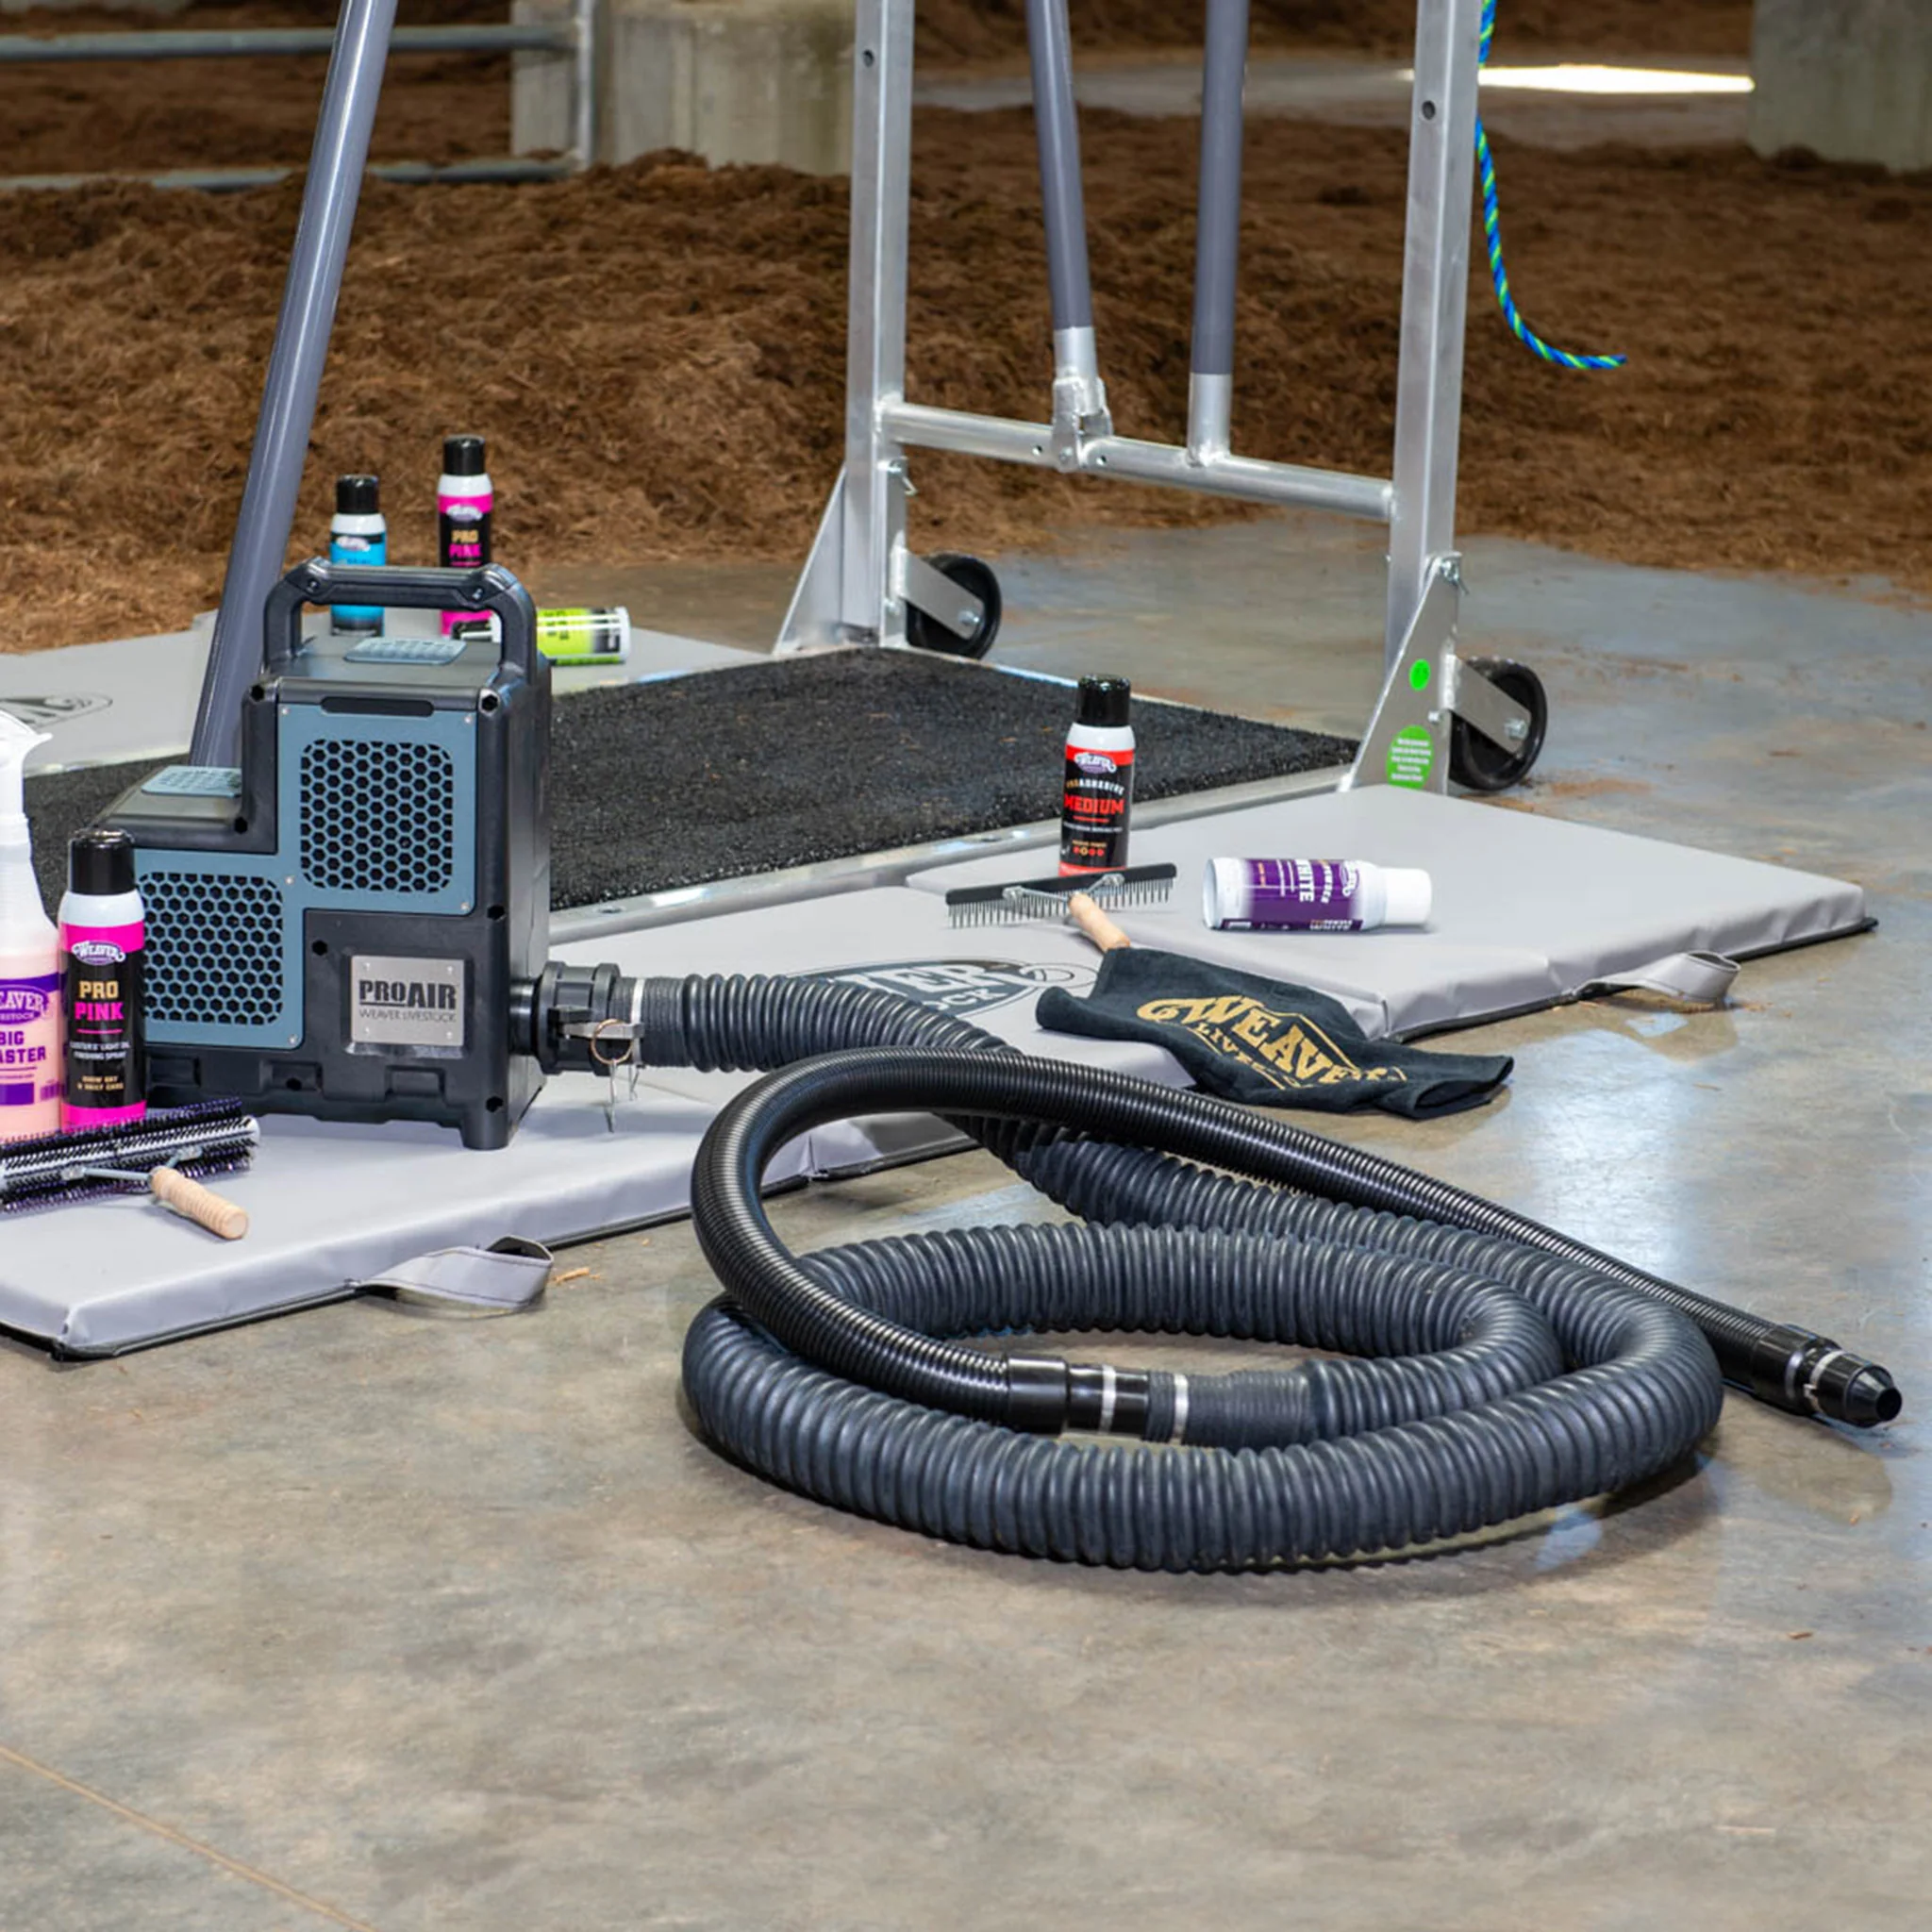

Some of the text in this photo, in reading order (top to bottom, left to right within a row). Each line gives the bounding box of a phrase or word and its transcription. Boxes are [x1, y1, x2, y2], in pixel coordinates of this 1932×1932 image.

[1063, 794, 1125, 815] MEDIUM
[79, 980, 119, 1000] PRO
[75, 1002, 125, 1021] PINK
[0, 1030, 25, 1046] BIG
[0, 1045, 46, 1063] ASTER
